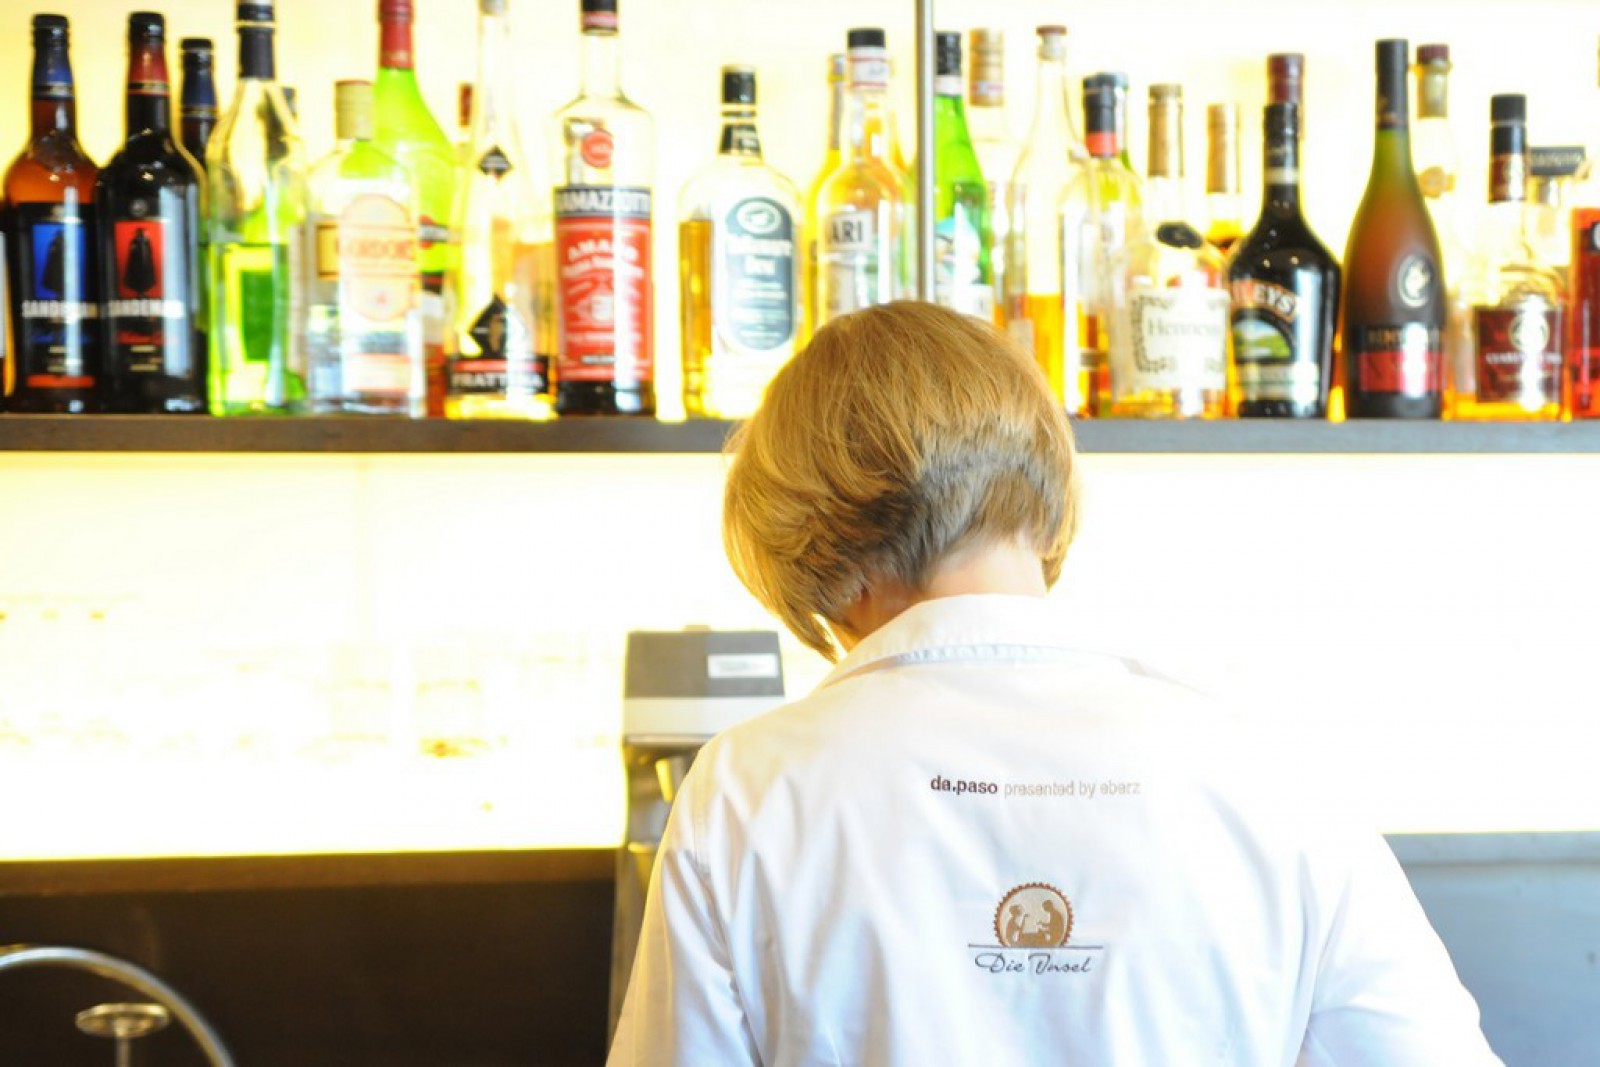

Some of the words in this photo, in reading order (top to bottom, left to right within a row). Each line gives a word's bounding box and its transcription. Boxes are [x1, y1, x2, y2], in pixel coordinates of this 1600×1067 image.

[930, 775, 998, 795] da.paso
[1004, 780, 1074, 799] presented
[1079, 780, 1096, 799] by
[975, 952, 1025, 974] Die
